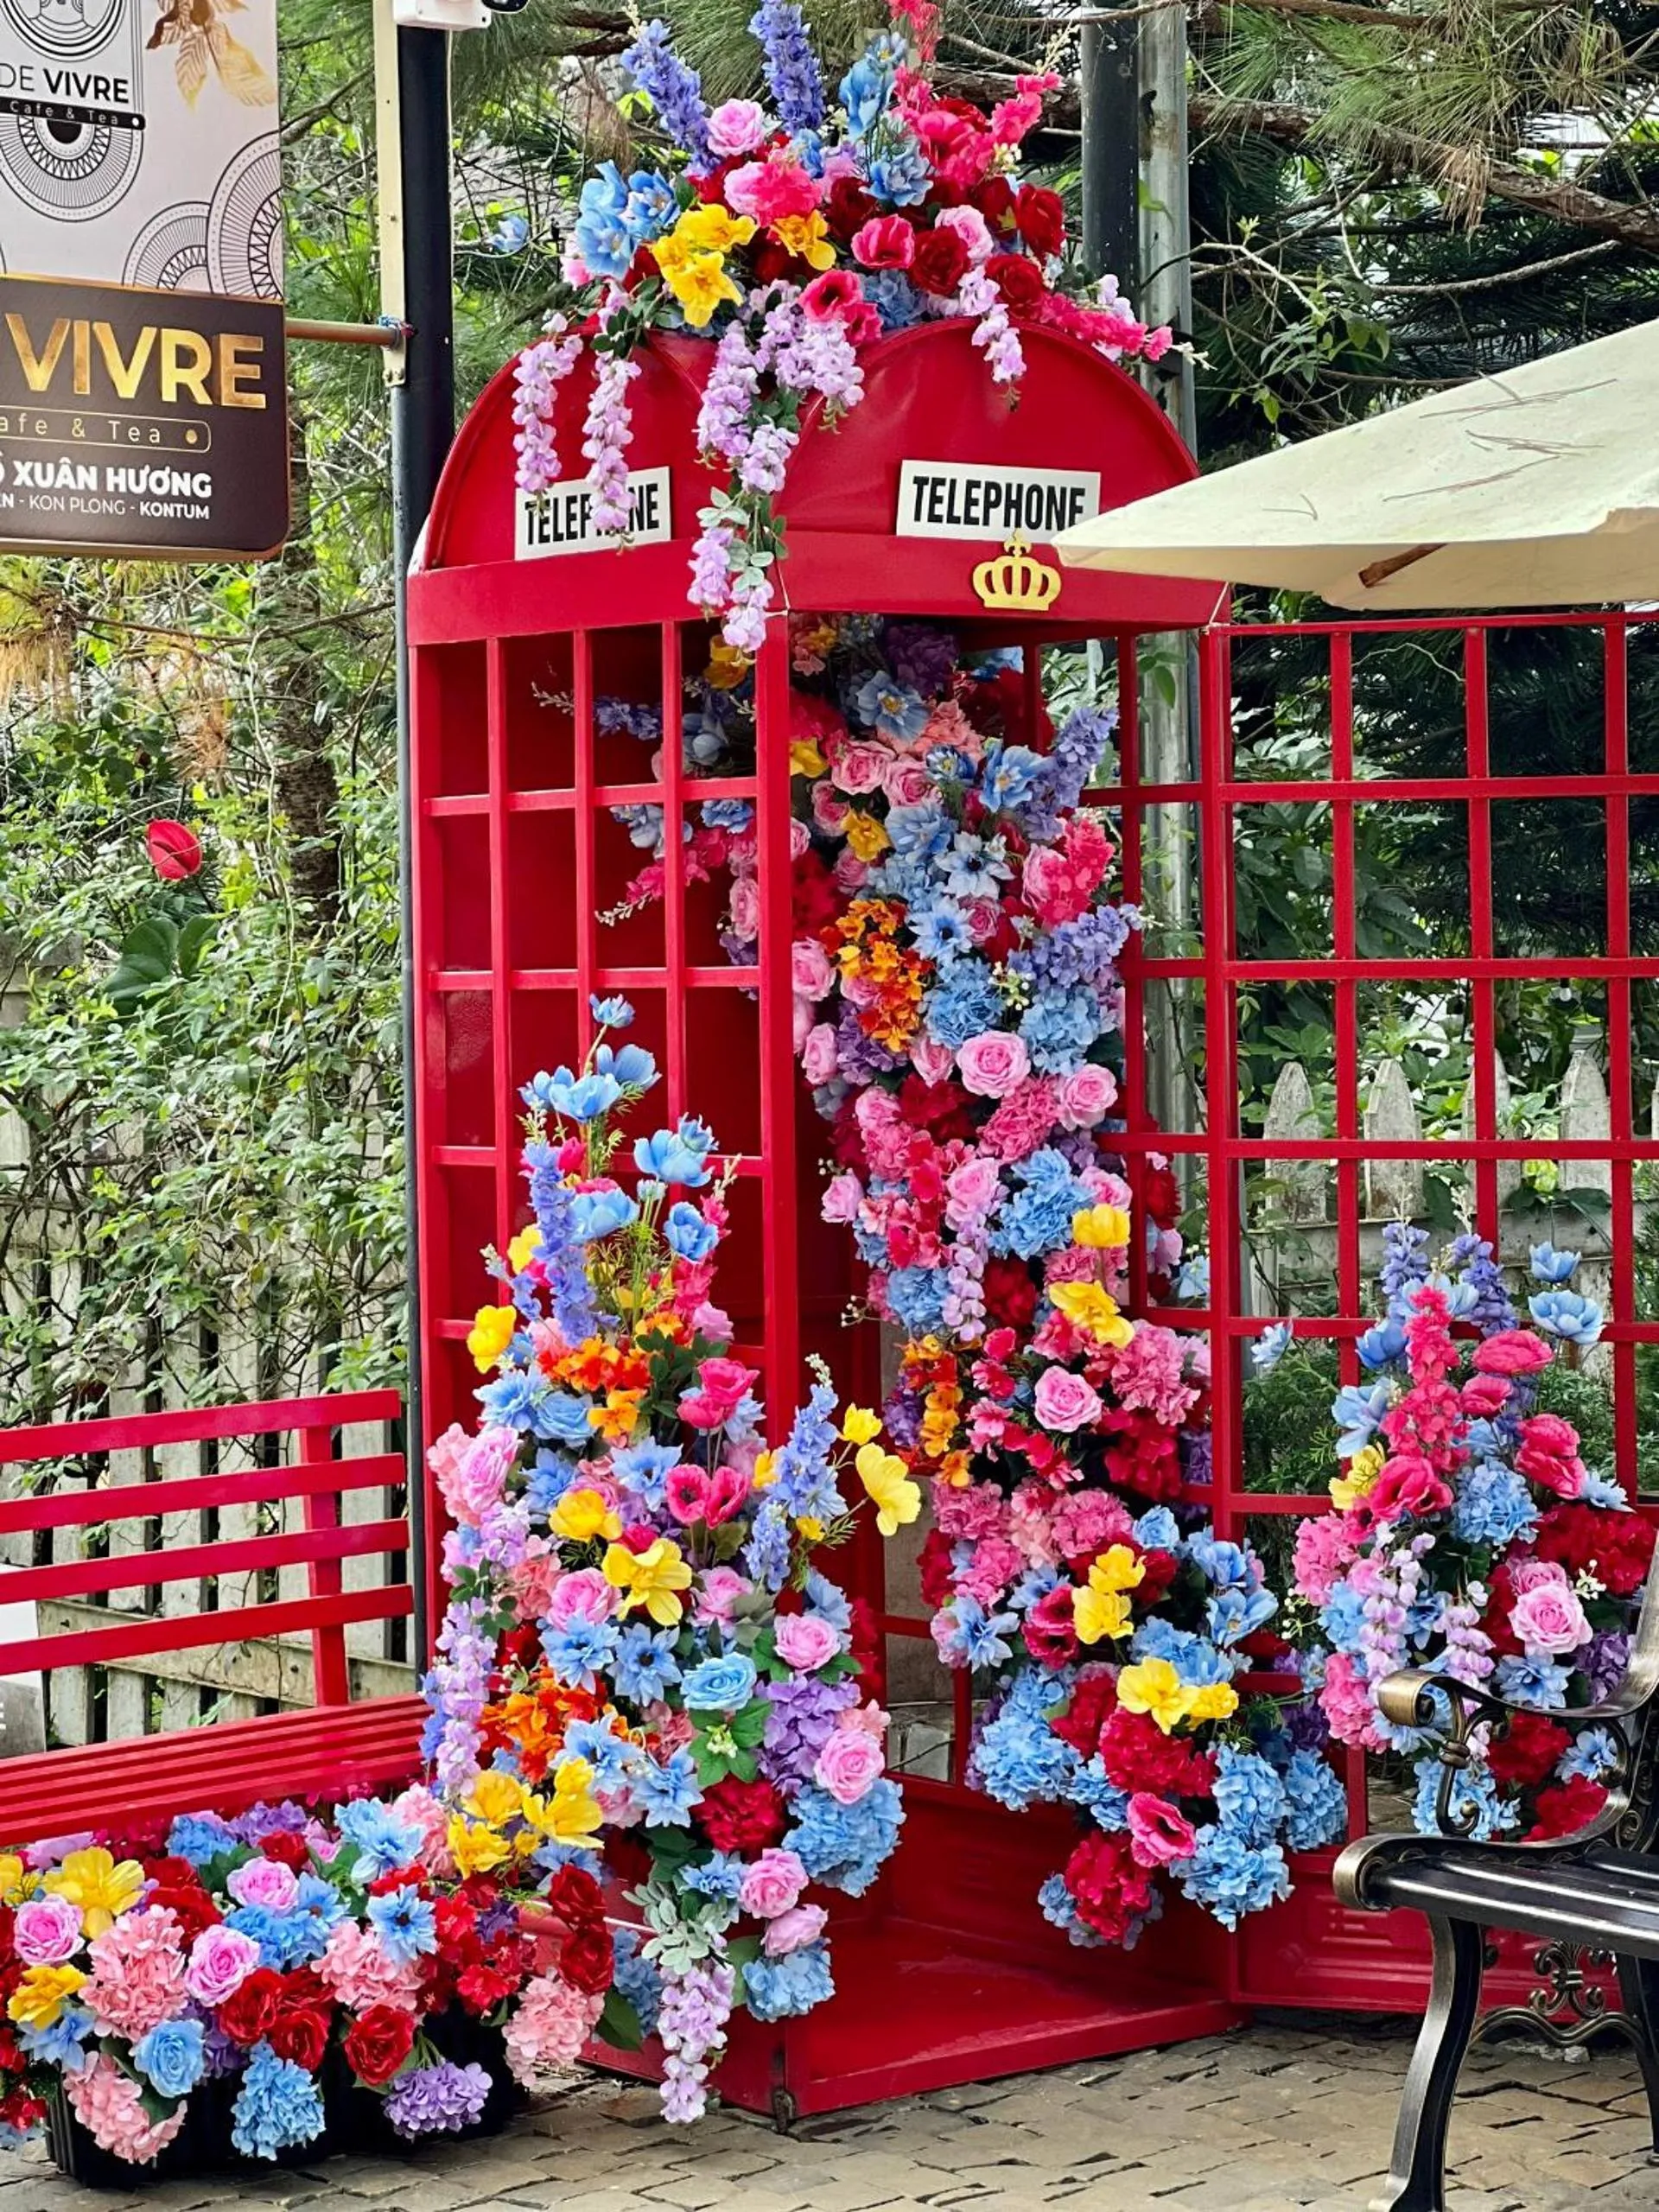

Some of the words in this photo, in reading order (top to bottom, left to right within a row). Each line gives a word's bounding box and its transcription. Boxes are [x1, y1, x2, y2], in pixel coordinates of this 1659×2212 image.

[42, 67, 129, 104] VIVRE
[10, 100, 54, 118] Cafe
[66, 107, 75, 119] &
[87, 110, 119, 125] Tea
[5, 313, 266, 410] VIVRE
[72, 418, 86, 437] &
[108, 420, 161, 443] Tea
[13, 456, 98, 491] XUÂN
[105, 464, 212, 499] HƯƠNG
[29, 494, 66, 512] KON
[70, 496, 126, 516] PLONG
[140, 501, 210, 520] KONTUM
[524, 483, 659, 545] TELEPNE
[912, 475, 1086, 532] TELEPHONE
